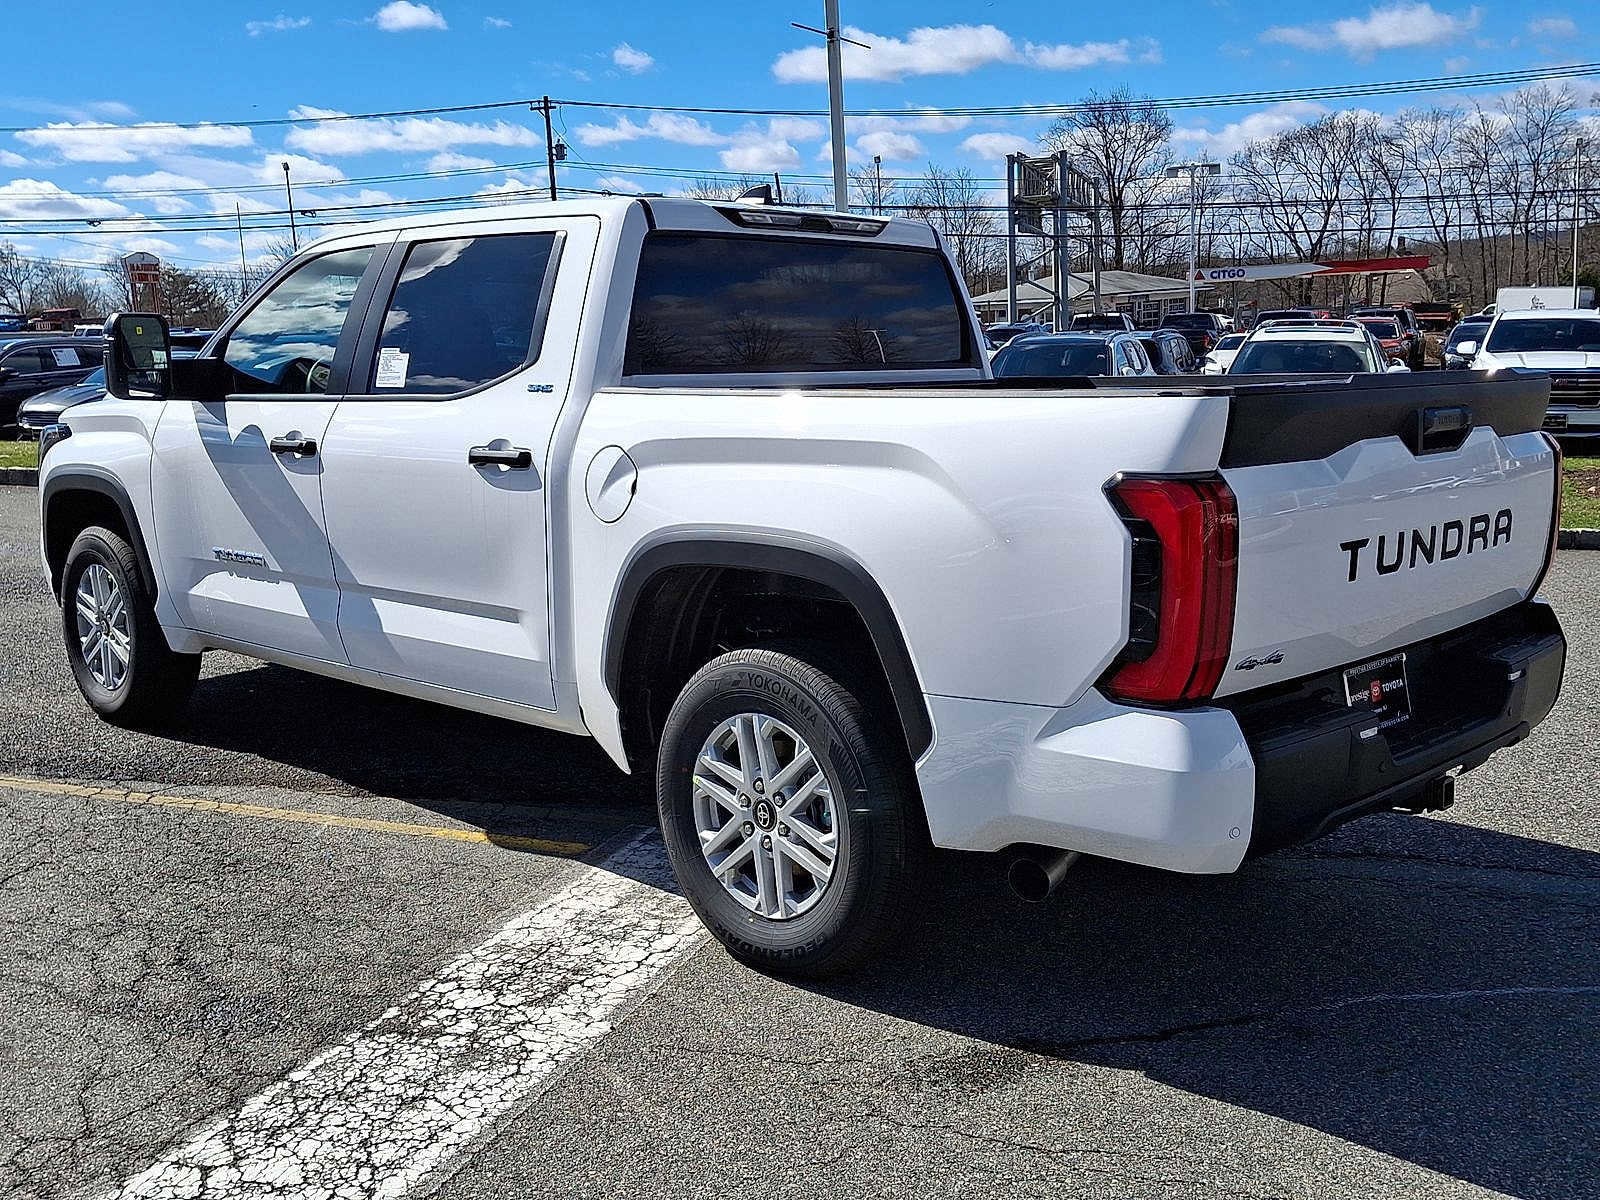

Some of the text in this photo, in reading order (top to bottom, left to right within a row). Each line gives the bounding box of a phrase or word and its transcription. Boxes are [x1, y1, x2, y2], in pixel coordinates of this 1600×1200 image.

[1210, 268, 1246, 280] CITGO
[1339, 508, 1513, 582] TUNDRA
[747, 672, 818, 728] YOKOHAMA
[1381, 678, 1404, 693] TOYOTA
